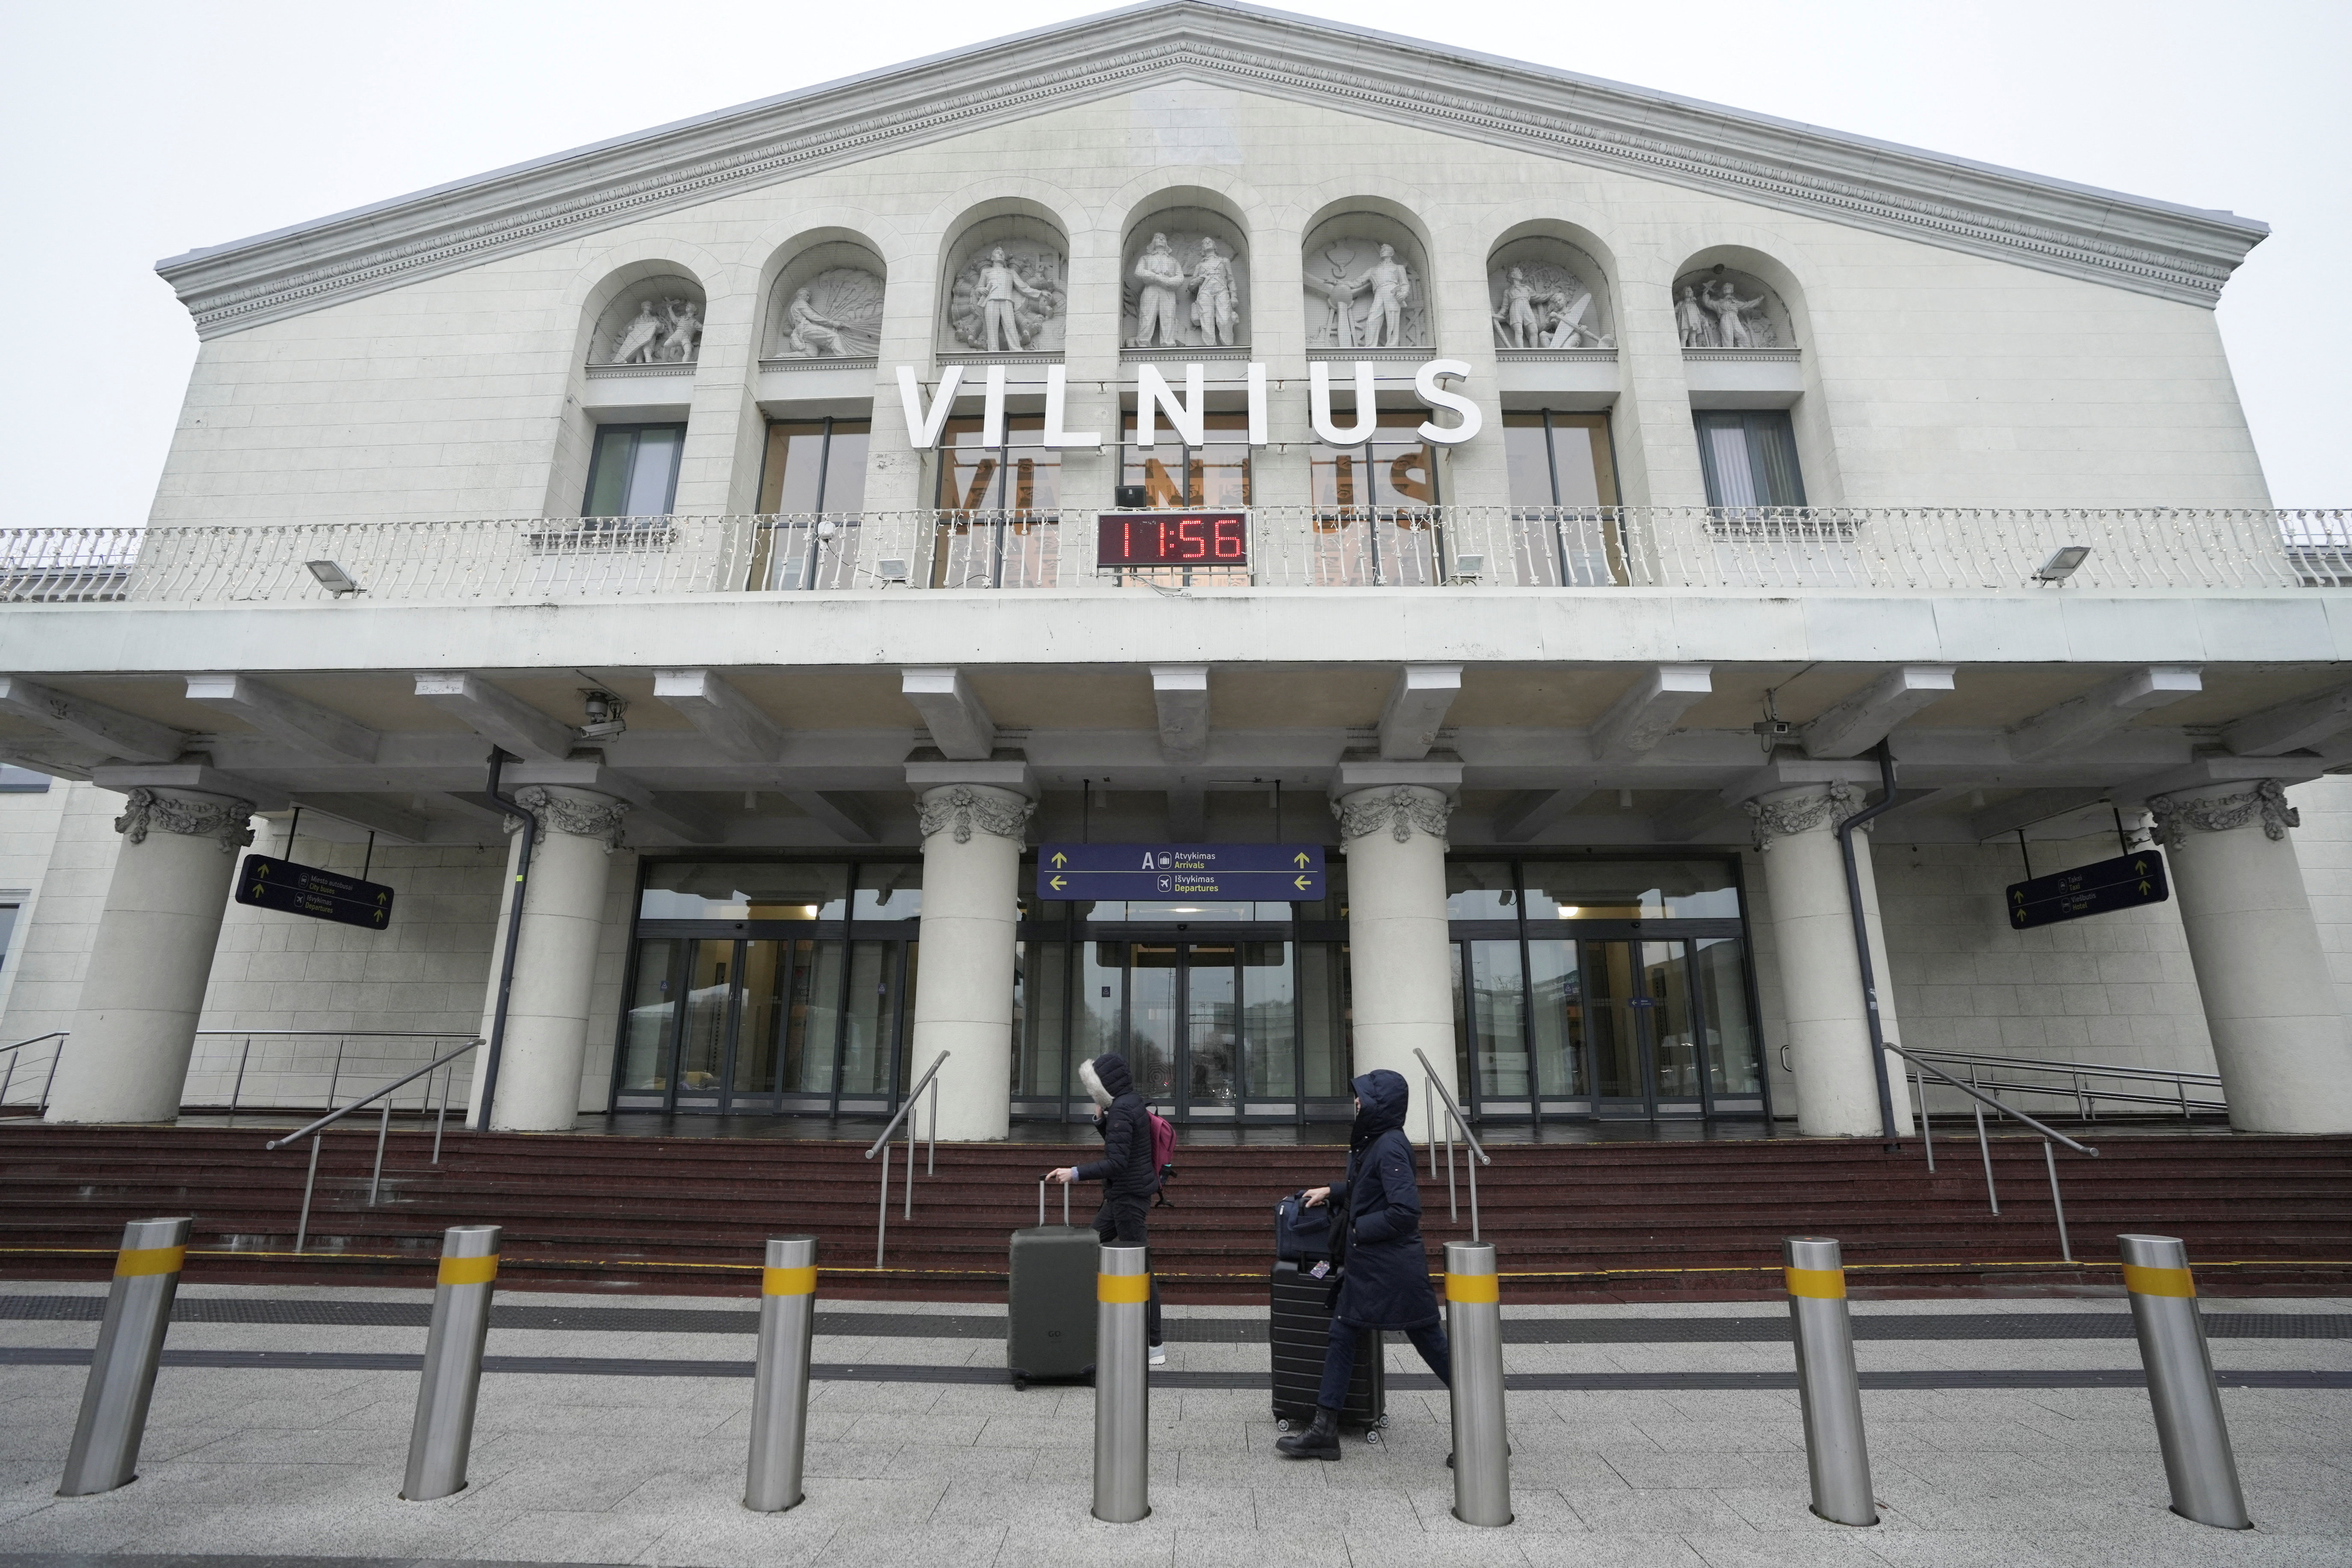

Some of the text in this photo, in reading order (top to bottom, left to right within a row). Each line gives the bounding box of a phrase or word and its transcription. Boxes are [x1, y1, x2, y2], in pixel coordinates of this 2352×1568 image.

[896, 359, 1483, 452] VILNIUS
[1124, 519, 1241, 557] 11:56
[1142, 852, 1216, 869] A Atvykimas
[310, 875, 353, 890] Miesto autobusai
[1175, 875, 1214, 884] Išvykimas
[2068, 874, 2082, 883] Taksi
[309, 883, 335, 894] City buses
[1175, 884, 1219, 893] Departures
[2069, 883, 2080, 891] Taxi
[307, 895, 332, 906] Išvykimas
[2071, 892, 2096, 903] Viešbutis
[305, 902, 333, 913] Departures
[2072, 901, 2088, 910] Hotel
